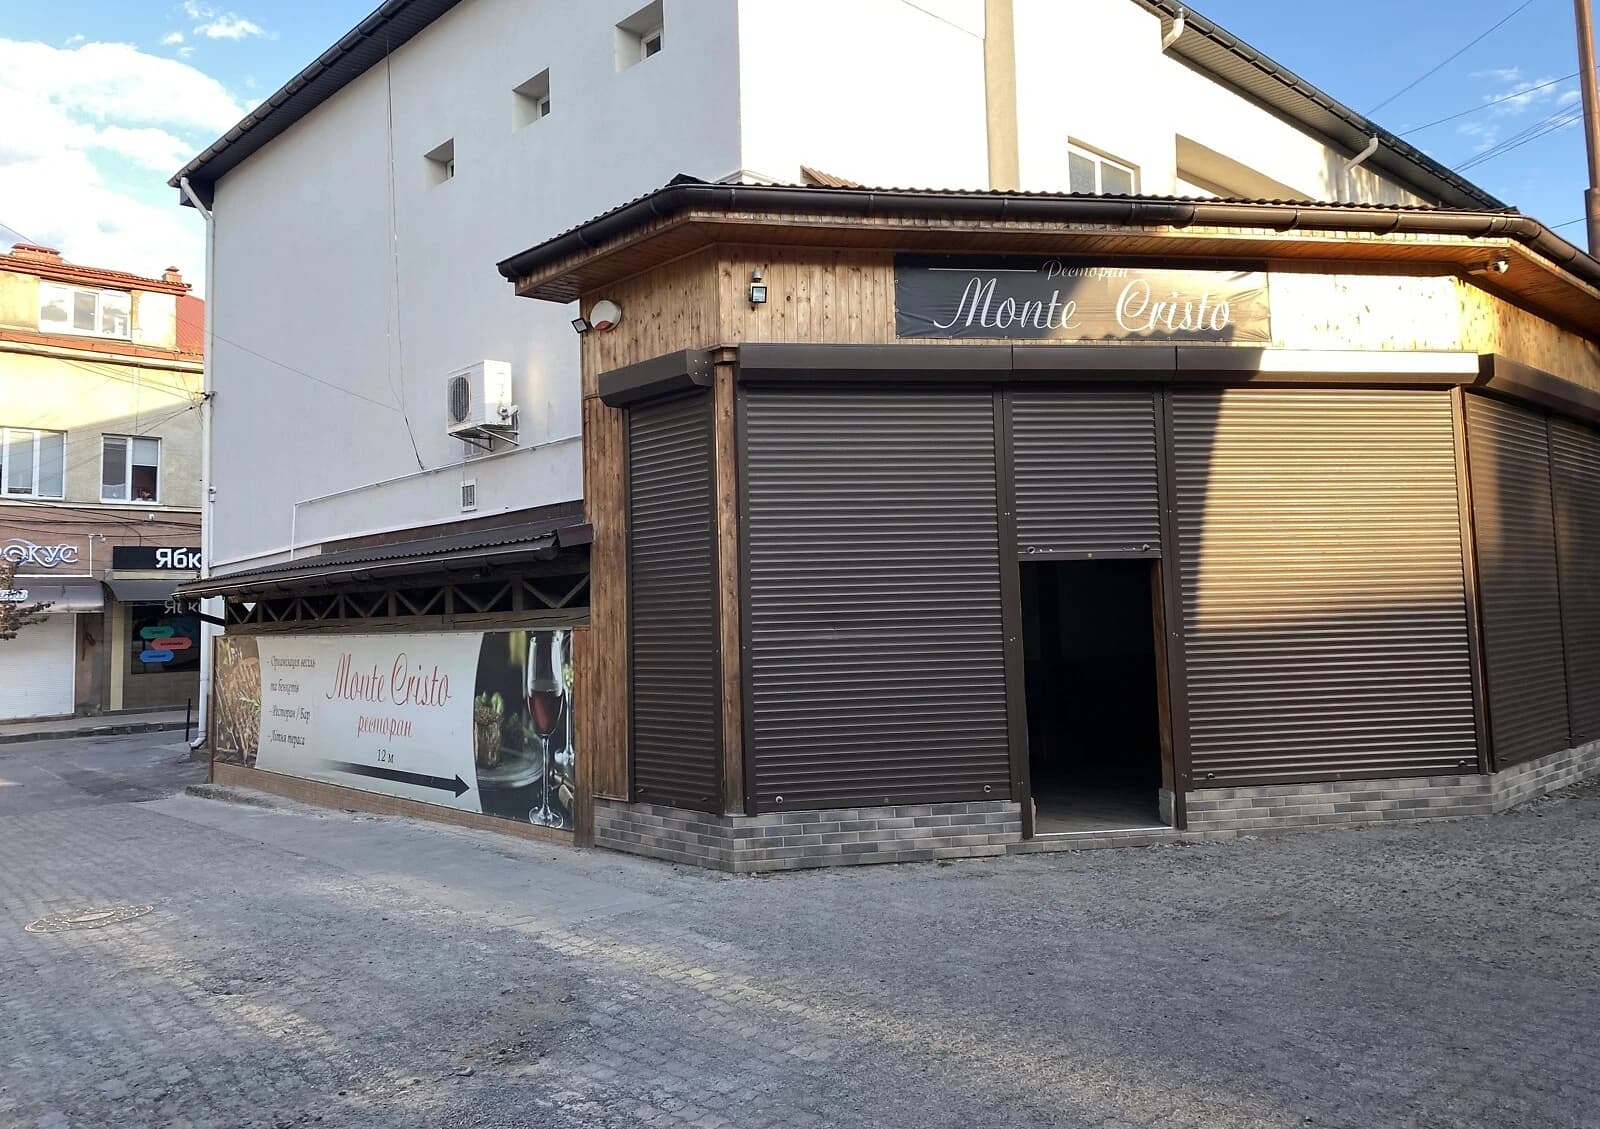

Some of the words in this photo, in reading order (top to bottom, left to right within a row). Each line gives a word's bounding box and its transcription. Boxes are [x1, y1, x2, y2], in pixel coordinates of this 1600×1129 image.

[933, 276, 1080, 329] Monte
[1115, 278, 1235, 332] Cristo
[326, 652, 385, 703] Monte
[391, 652, 452, 707] Cristo
[300, 707, 311, 725] Бар
[357, 715, 413, 742] ресторан
[377, 749, 387, 762] 12
[387, 753, 394, 763] м
